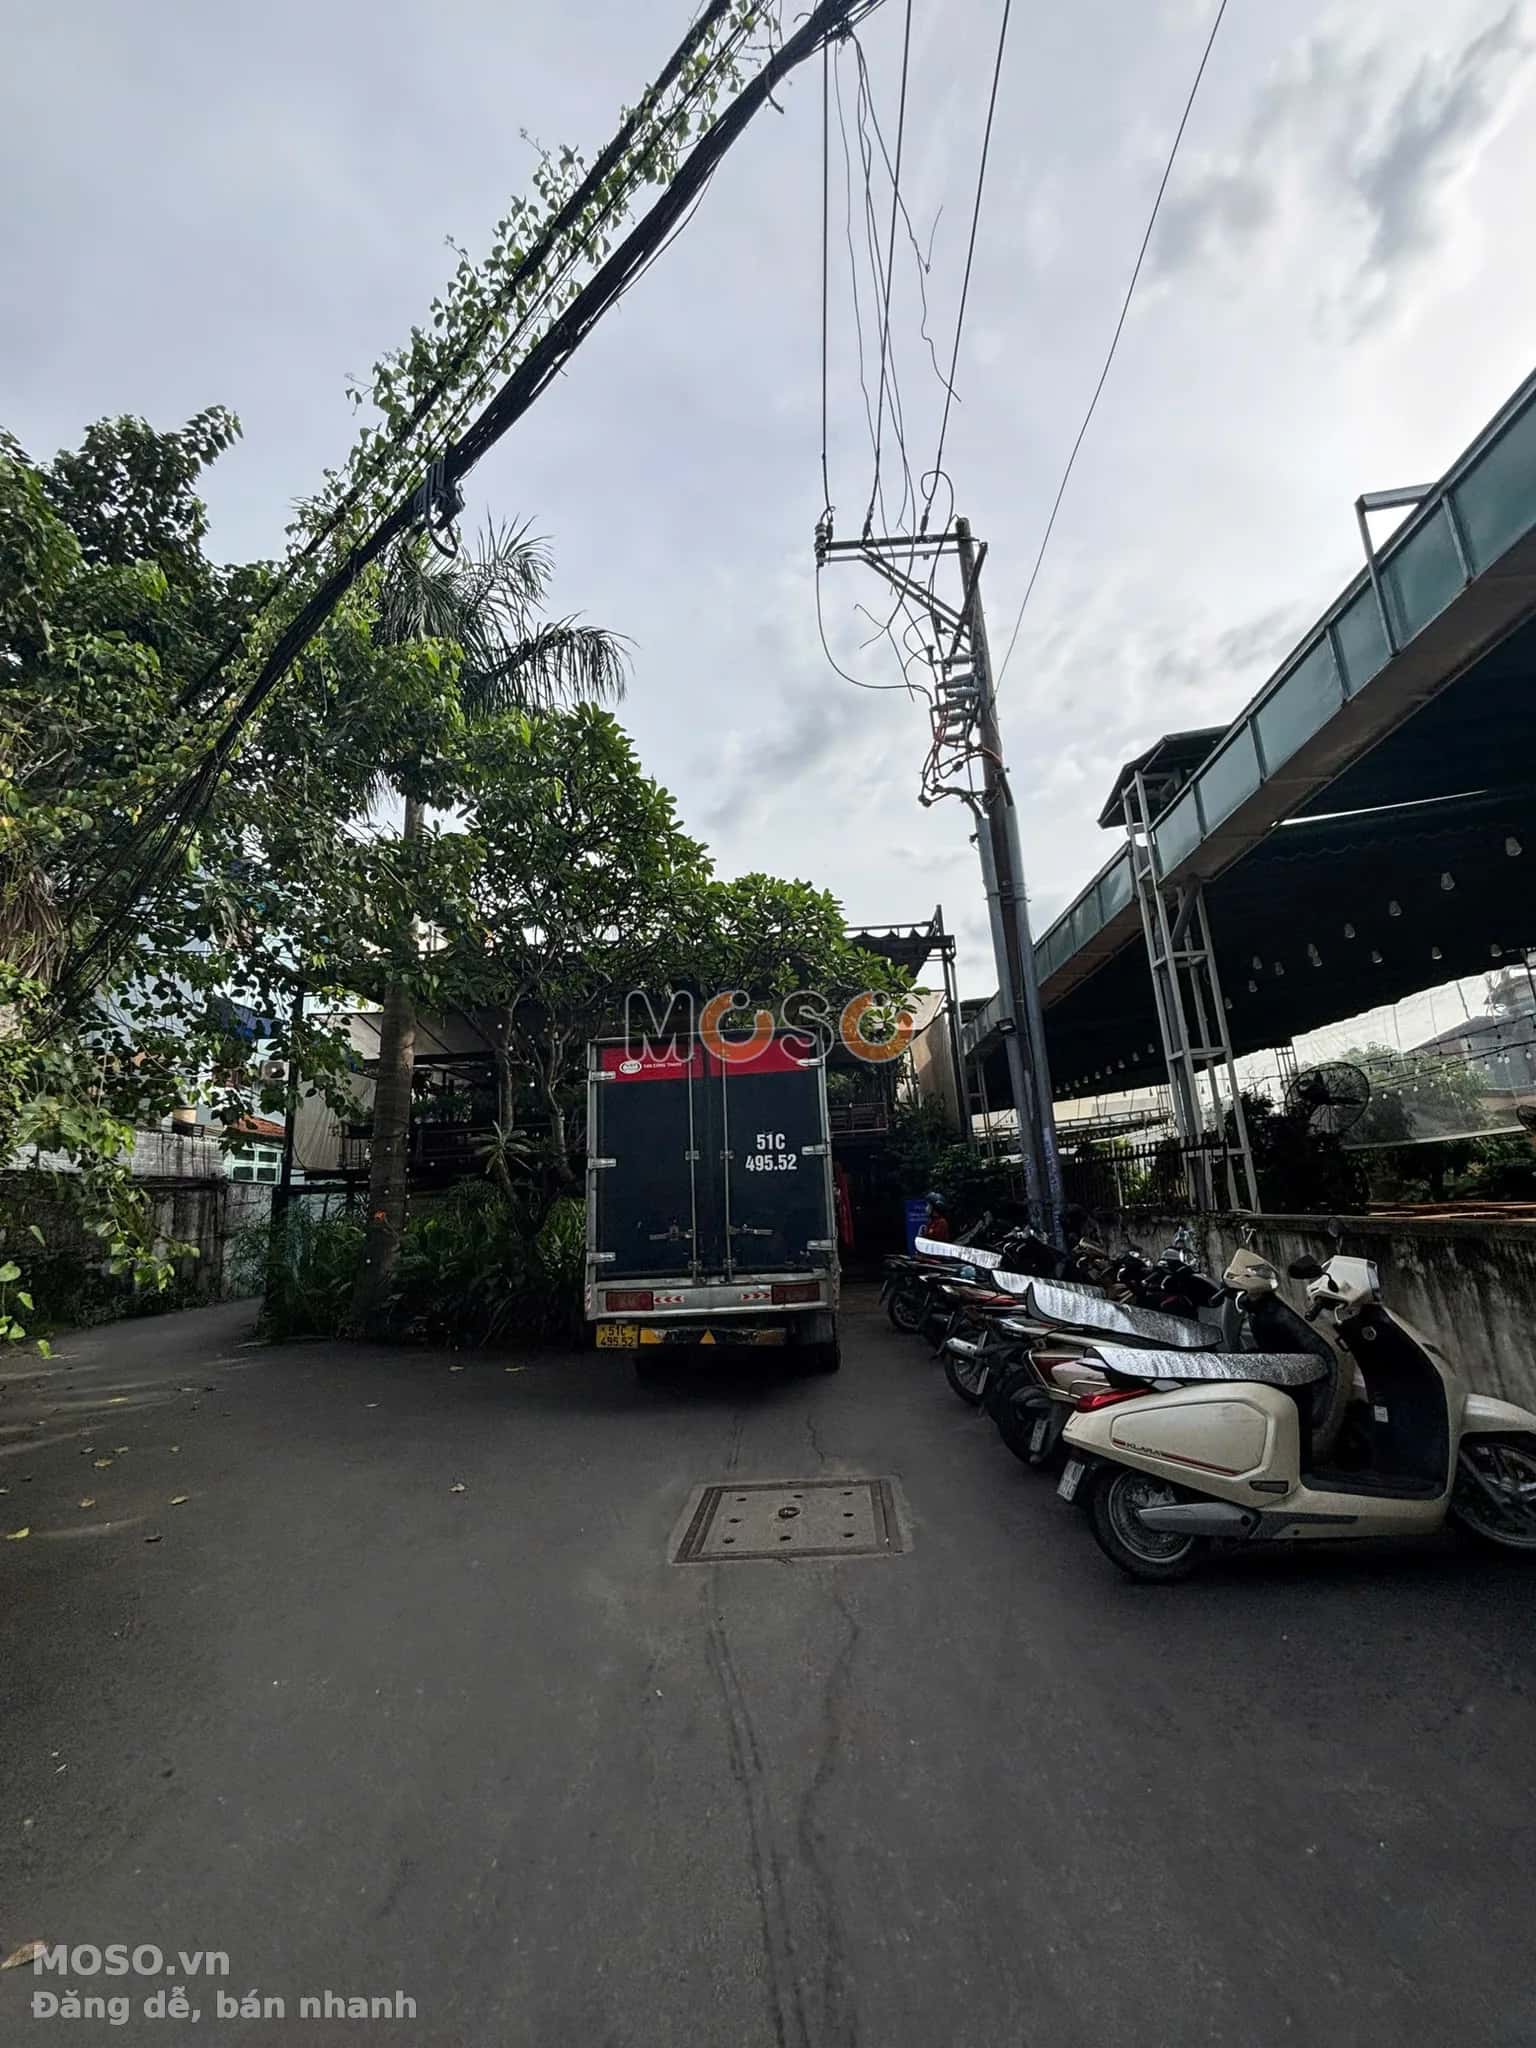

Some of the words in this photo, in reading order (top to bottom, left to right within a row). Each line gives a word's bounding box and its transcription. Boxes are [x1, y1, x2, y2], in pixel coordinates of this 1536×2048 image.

[756, 1133, 786, 1150] 51C
[745, 1153, 798, 1172] 495.52
[608, 1325, 625, 1337] 51C
